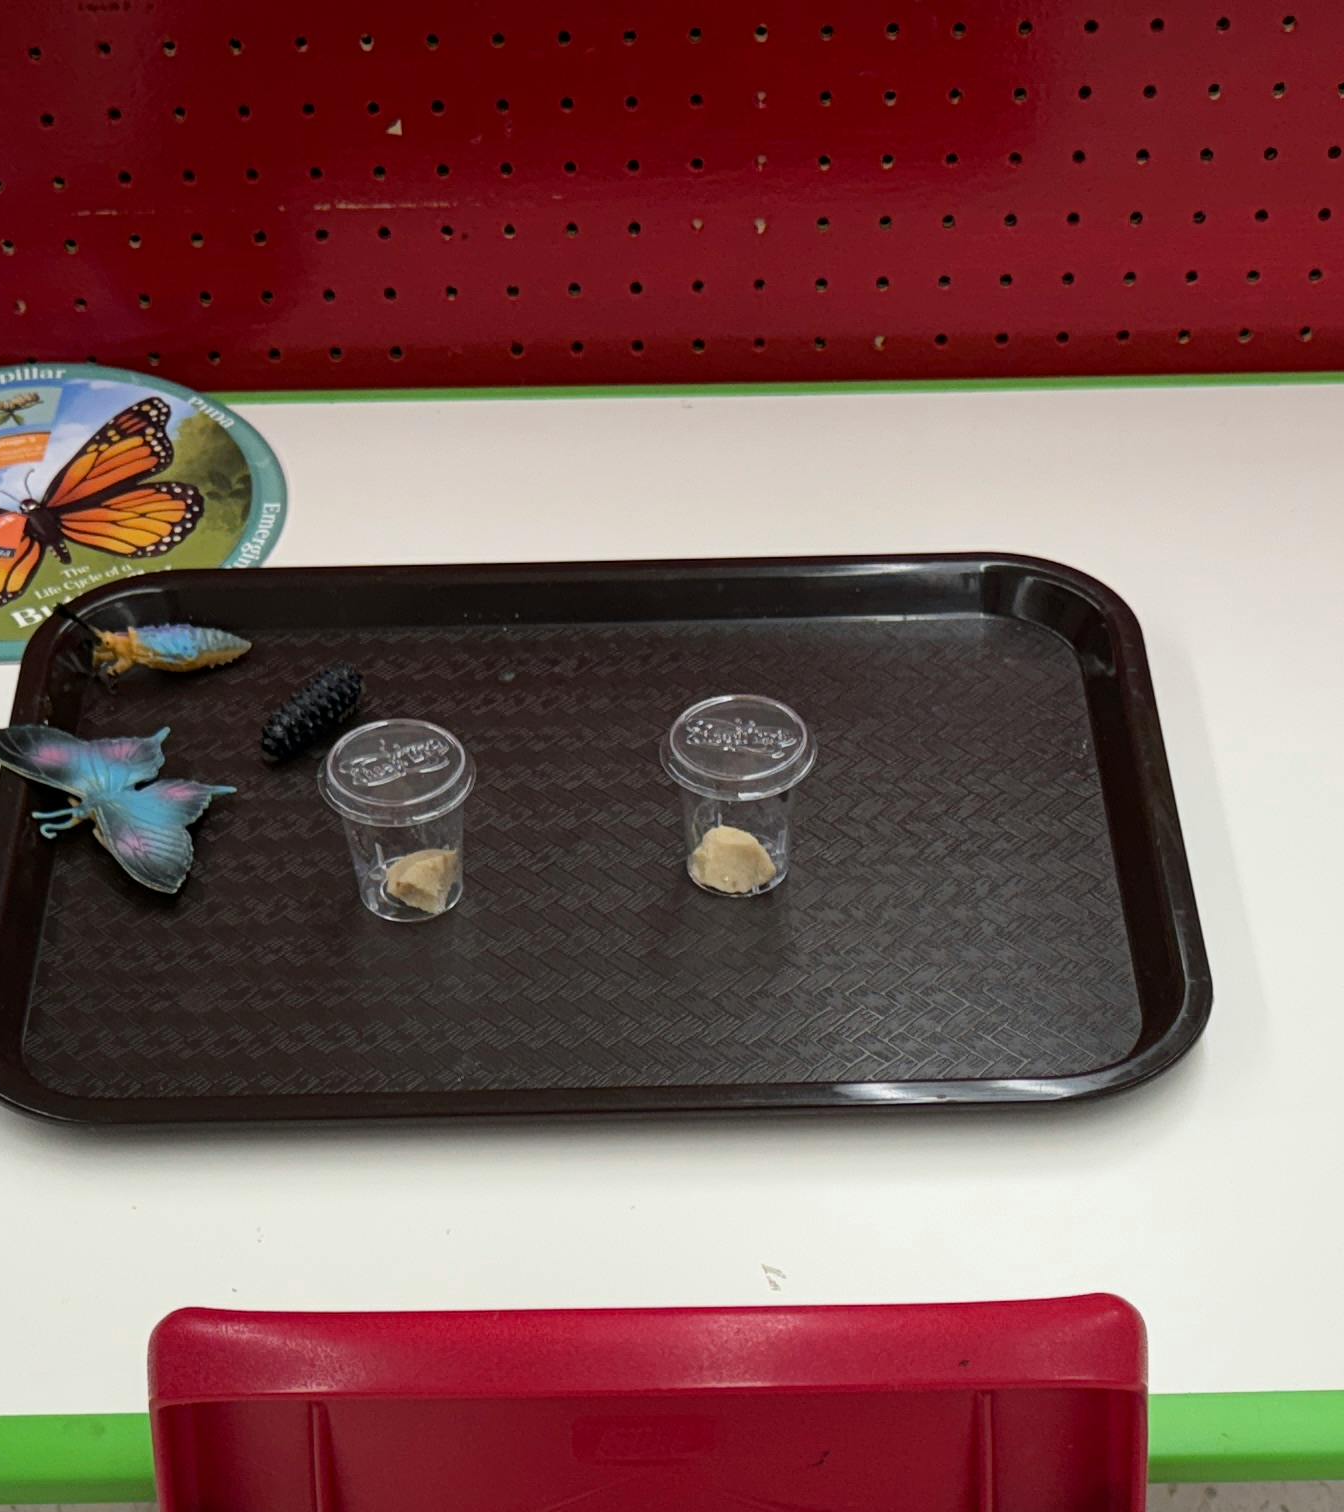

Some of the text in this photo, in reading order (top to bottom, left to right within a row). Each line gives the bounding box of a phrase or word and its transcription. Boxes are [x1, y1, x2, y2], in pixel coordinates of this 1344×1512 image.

[223, 502, 281, 568] Emergin
[34, 586, 62, 600] Life
[63, 573, 103, 591] Cycle
[105, 565, 119, 578] of
[63, 565, 90, 579] The
